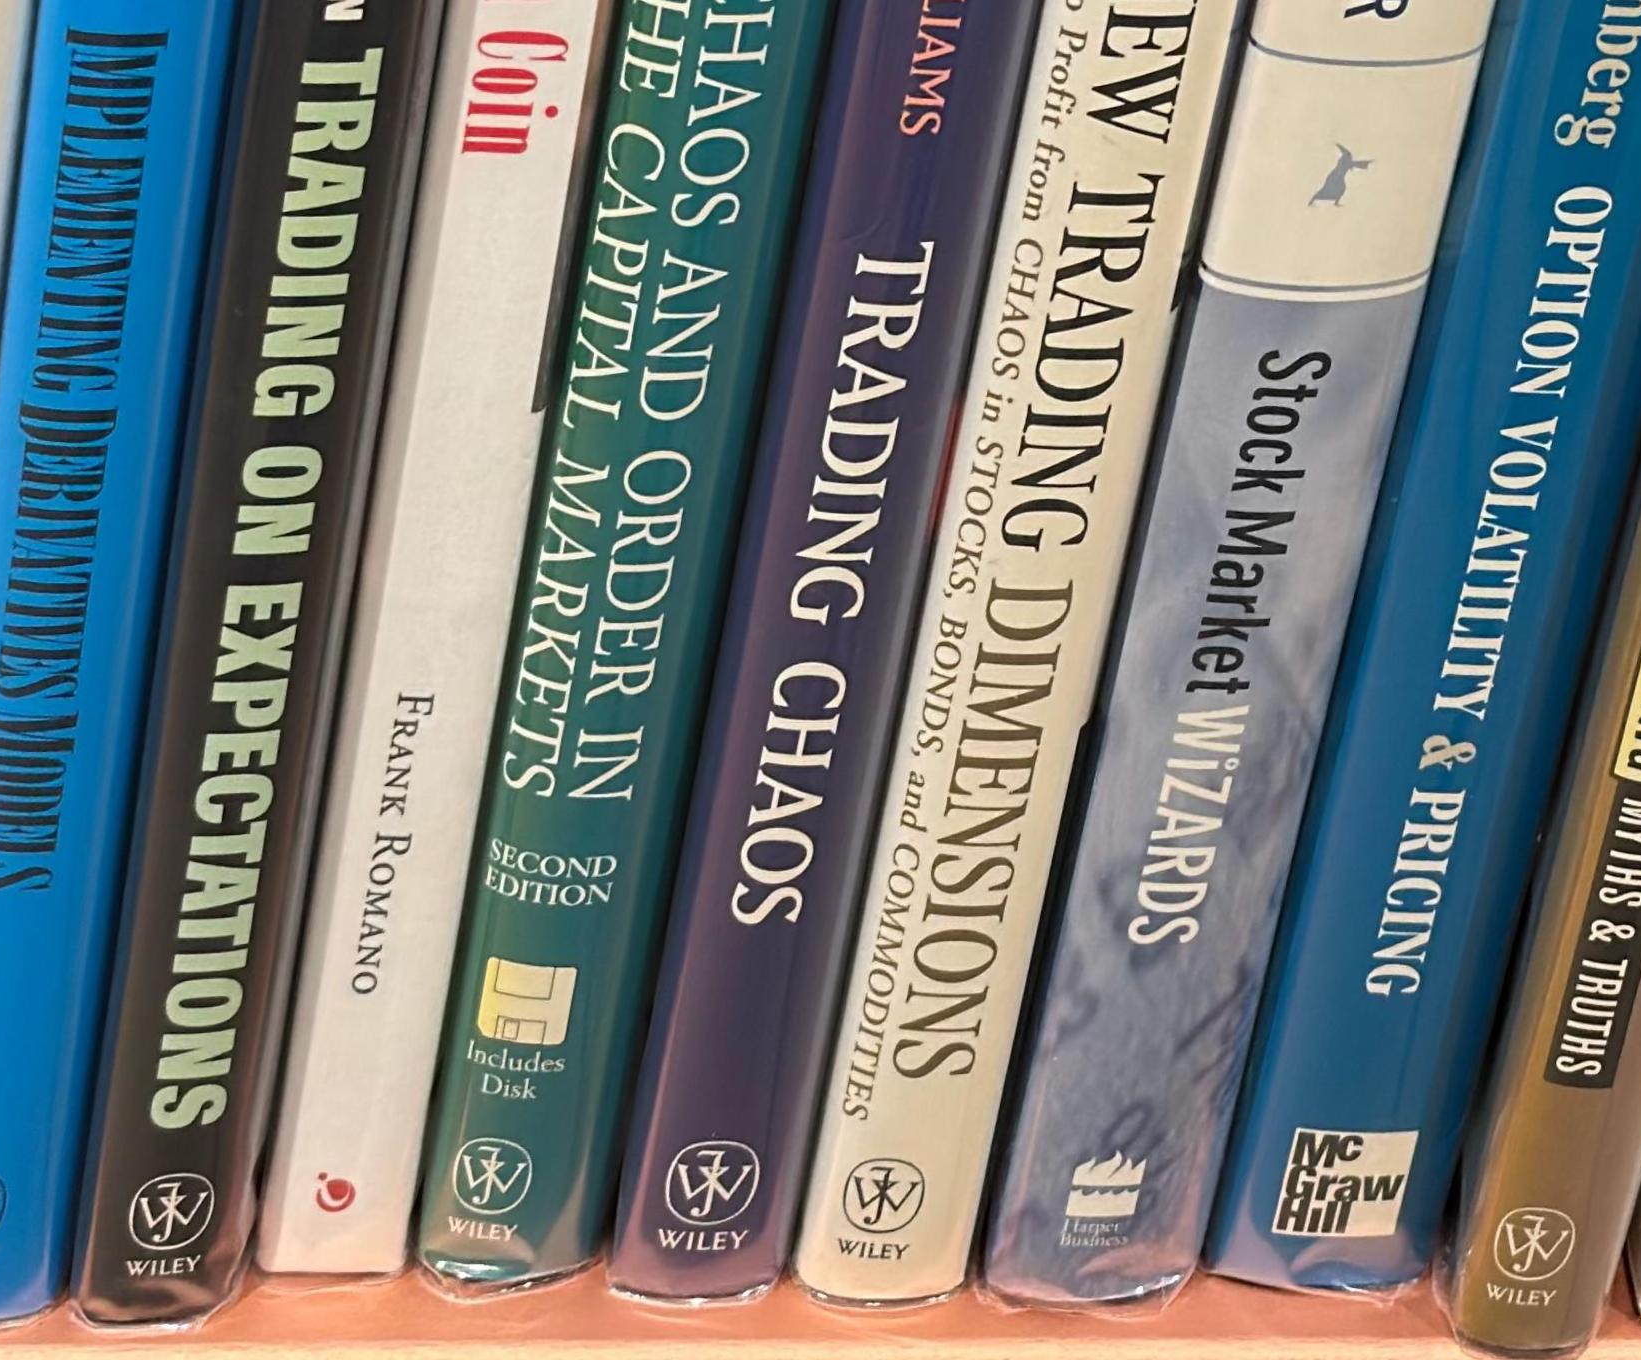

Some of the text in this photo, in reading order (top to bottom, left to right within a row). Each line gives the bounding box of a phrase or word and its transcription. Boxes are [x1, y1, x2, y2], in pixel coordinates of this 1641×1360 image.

[461, 30, 569, 156] Coin
[1041, 27, 1089, 131] Profit
[31, 25, 169, 392] IMPLEMENTING
[252, 46, 382, 418] TRADING
[1022, 143, 1066, 223] from
[567, 122, 666, 430] CAPITAL
[639, 258, 729, 422] AND
[991, 235, 1046, 383] CHAOS
[1508, 186, 1615, 398] OPTION
[999, 171, 1166, 554] TRADING
[232, 446, 324, 557] ON
[790, 240, 934, 627] TRADING
[591, 449, 692, 700] ORDER
[941, 435, 1003, 600] STOCKS,
[1185, 349, 1332, 696] Stock Market
[1442, 414, 1560, 723] VOLATILITY
[500, 455, 610, 798] MARKETS
[914, 620, 967, 756] BONDS,
[567, 731, 633, 802] IN
[730, 660, 847, 926] CHAOS
[898, 772, 926, 833] and
[1420, 734, 1477, 773] &
[150, 582, 300, 1132] EXPECTATIONS
[354, 692, 435, 996] FRANK ROMANO
[485, 866, 613, 907] EDITION
[489, 839, 617, 880] SECOND
[892, 576, 1074, 1081] DIMENSIONS
[1365, 787, 1467, 1000] PRICING
[842, 842, 919, 1121] COMMODITIES
[1588, 918, 1636, 943] &
[466, 1042, 565, 1075] Includes
[1556, 952, 1630, 1079] TRUTHS
[480, 1073, 537, 1100] Disk
[448, 1216, 518, 1241] WILEY
[659, 1228, 748, 1251] WILEY
[838, 1238, 908, 1262] WILEY
[1285, 1166, 1404, 1203] Graw
[126, 1255, 201, 1278] WILEY
[1487, 1281, 1556, 1309] WILEY
